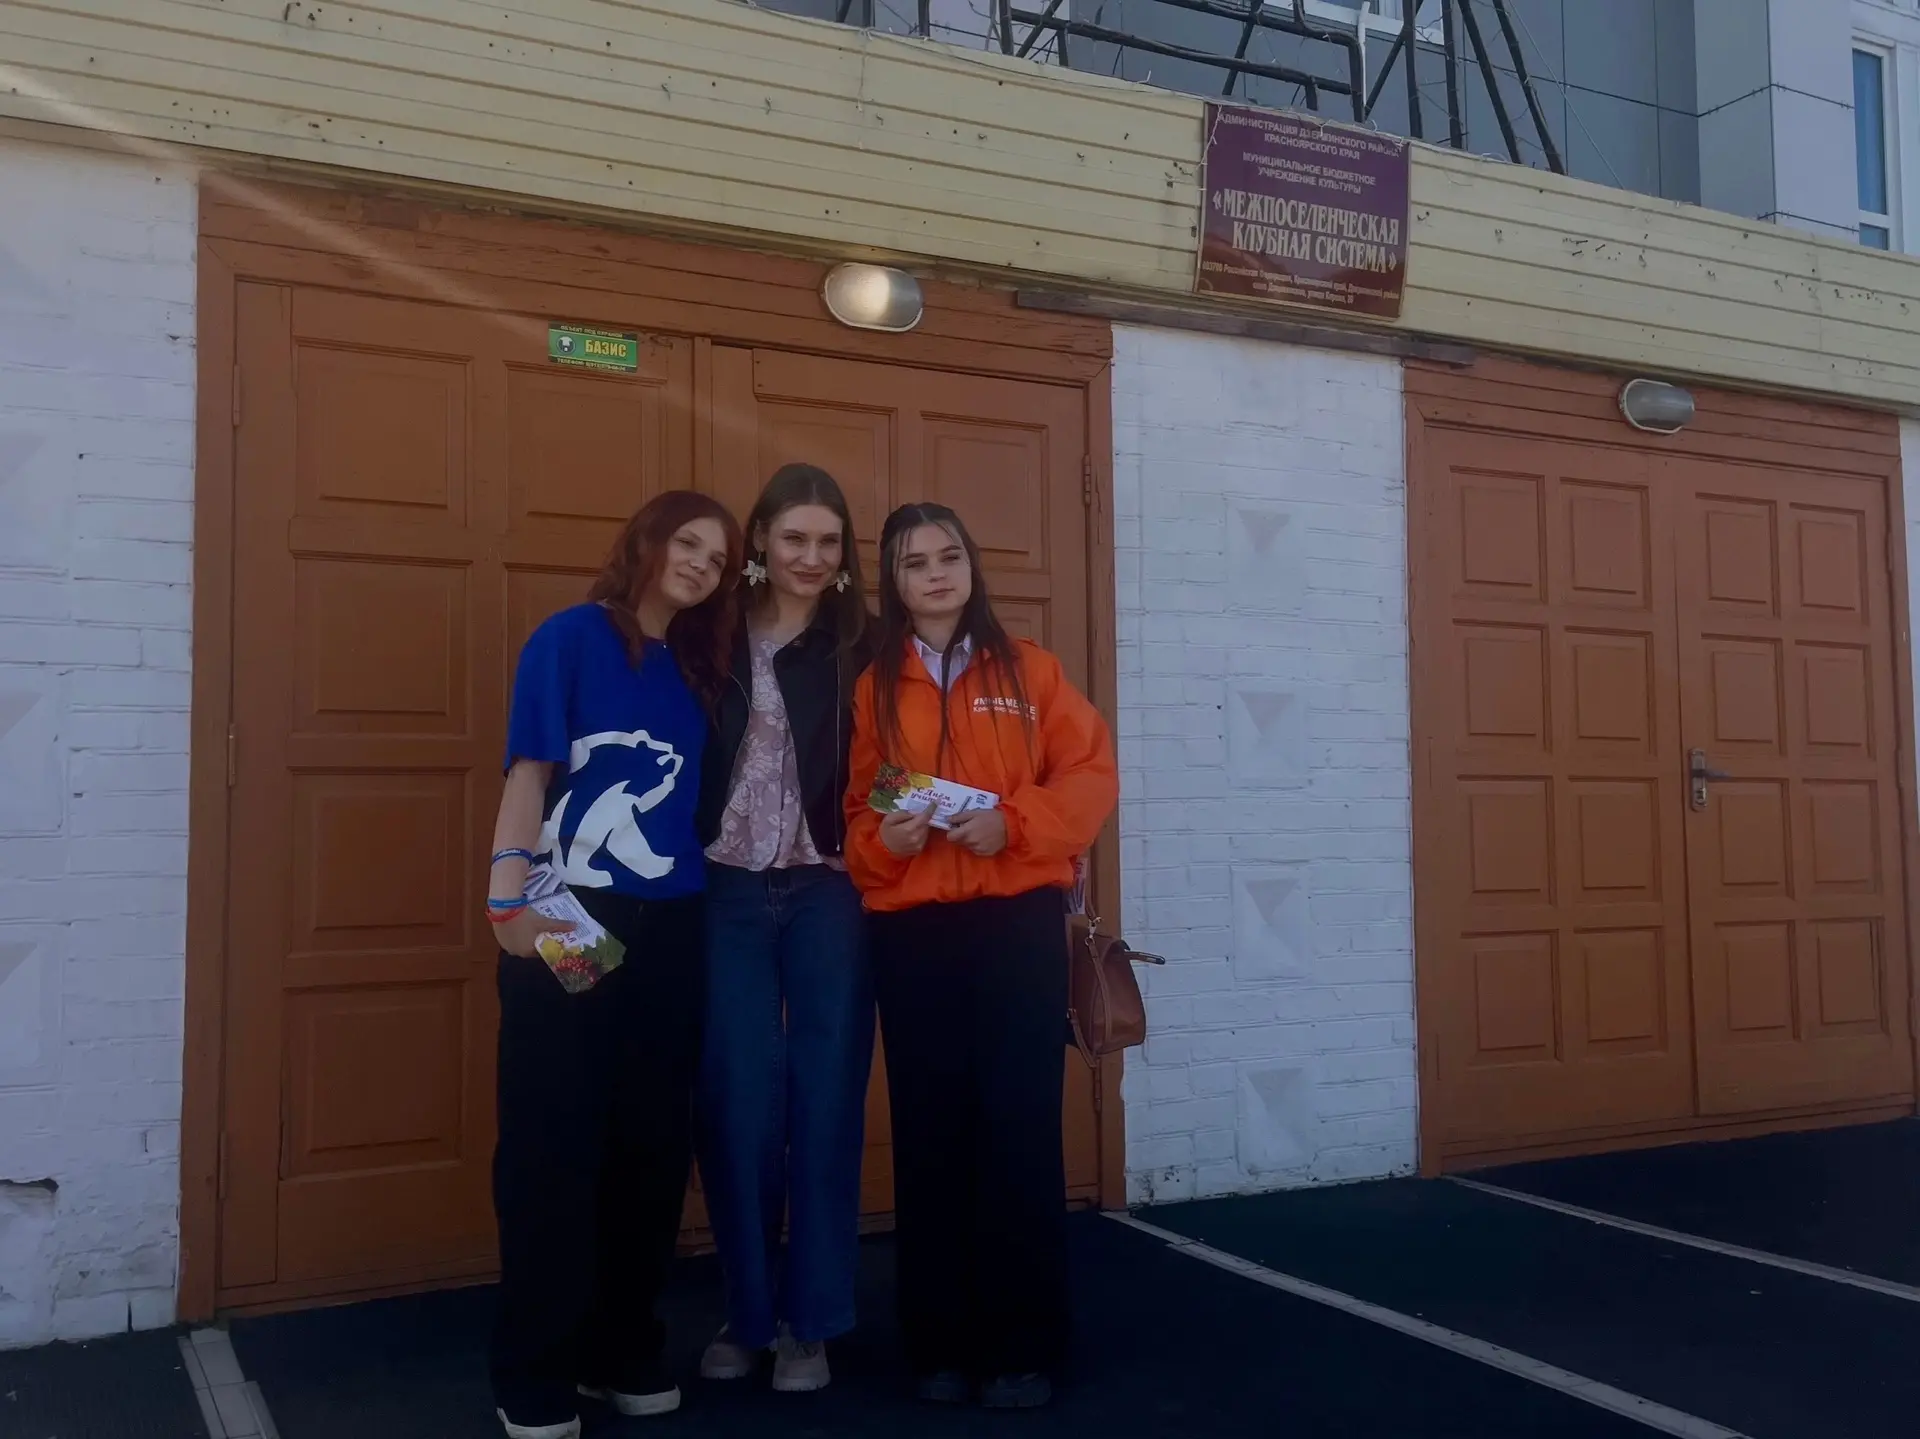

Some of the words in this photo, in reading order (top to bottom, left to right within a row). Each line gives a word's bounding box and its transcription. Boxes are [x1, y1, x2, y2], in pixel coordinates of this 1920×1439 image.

[1219, 114, 1298, 136] АДМИНИСТРАЦИЯ
[1264, 134, 1338, 155] КРАСНОЯРСКОГО
[1338, 147, 1360, 160] КРАЯ
[1243, 152, 1321, 175] МУНИЦИПАЛЬНОЕ
[1323, 164, 1376, 186] БЮДЖЕТНОЕ
[1258, 167, 1316, 186] УЧРЕЖДЕНИЕ
[1318, 179, 1361, 195] КУЛЬТУРЫ
[1213, 188, 1399, 245] «МЕЖПОСЕЛЕНЧЕСКАЯ
[1232, 221, 1311, 261] КЛУБНАЯ
[1315, 236, 1397, 274] СИСТЕМА»
[585, 339, 627, 357] БАЗИС
